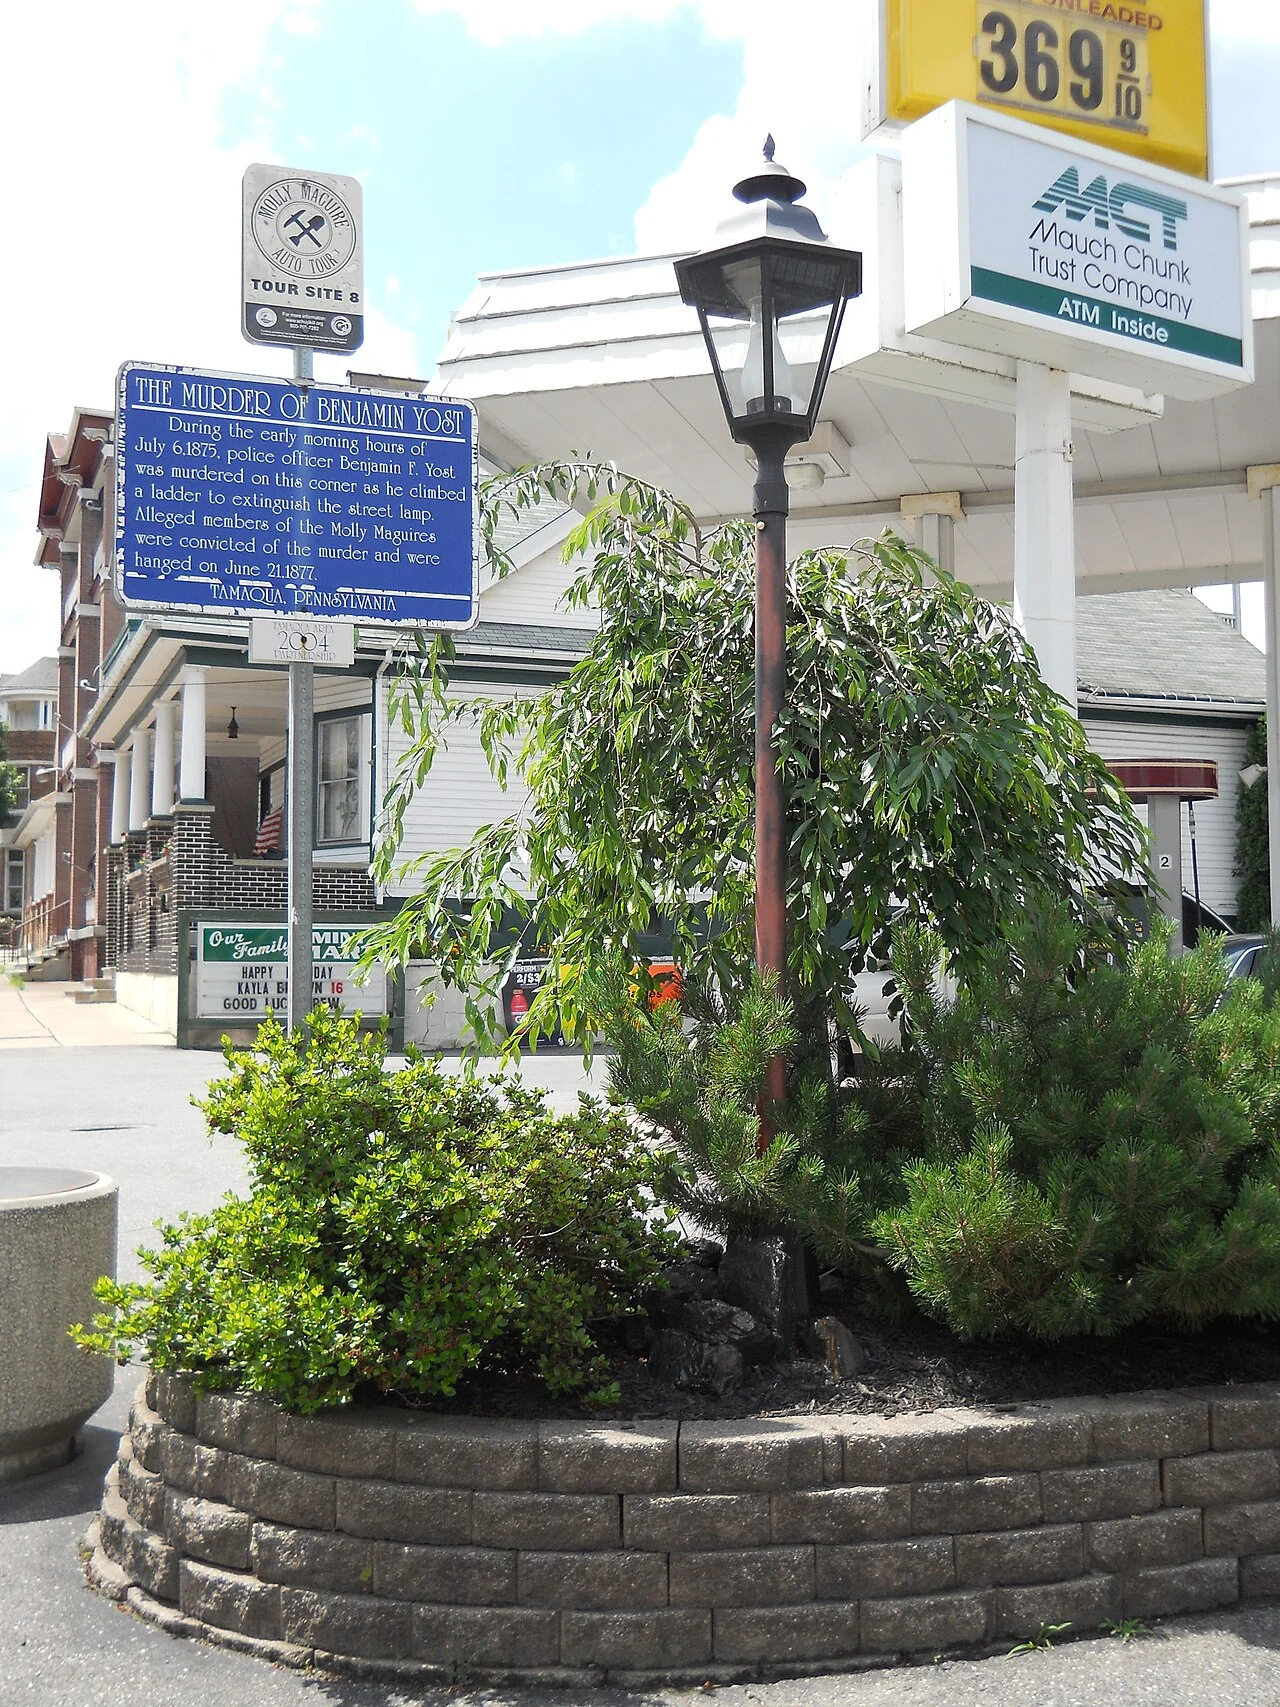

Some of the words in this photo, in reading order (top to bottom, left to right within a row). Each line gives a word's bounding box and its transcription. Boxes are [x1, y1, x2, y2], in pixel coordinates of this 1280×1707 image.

[980, 11, 1103, 111] 369
[258, 185, 292, 220] MOLLY
[301, 184, 350, 229] MAGUIRE
[1032, 165, 1188, 251] MCT
[272, 248, 302, 272] AUTO
[309, 253, 339, 274] TOUR
[1029, 219, 1116, 263] Mauch
[1124, 245, 1191, 285] Chunk
[251, 278, 299, 295] TOUR
[305, 286, 343, 301] SITE
[349, 292, 360, 303] 8
[1028, 247, 1076, 283] Trust
[1084, 263, 1193, 319] Company
[1058, 297, 1100, 325] ATM
[1111, 311, 1168, 342] Inside
[136, 377, 172, 406] THE
[182, 383, 271, 416] MURDER
[280, 393, 308, 420] OF
[317, 397, 404, 430] BENJAMIN
[413, 407, 464, 435] YOST
[169, 416, 221, 441] During
[229, 423, 254, 438] the
[261, 428, 296, 448] early
[304, 434, 358, 454] morning
[366, 435, 405, 453] hours
[411, 441, 427, 456] of
[135, 437, 165, 458] July
[227, 446, 275, 464] police
[282, 450, 334, 468] officer
[341, 455, 401, 477] Benjamin
[408, 461, 419, 476] F.
[425, 462, 456, 479] Yost
[135, 464, 164, 476] was
[171, 465, 244, 483] murdered
[251, 474, 269, 485] on
[275, 472, 303, 488] this
[309, 478, 357, 493] corner
[363, 483, 380, 496] as
[386, 481, 404, 497] he
[409, 484, 466, 502] climbed
[134, 487, 143, 498] a
[151, 484, 201, 503] ladder
[209, 489, 226, 504] to
[232, 493, 310, 514] extinguish
[317, 498, 342, 514] the
[348, 502, 393, 518] street
[400, 504, 434, 522] lamp.
[135, 507, 195, 528] Alleged
[203, 511, 269, 530] members
[276, 517, 294, 532] of
[300, 519, 324, 535] the
[331, 522, 366, 542] Molly
[374, 525, 437, 545] Maguires
[134, 552, 192, 575] hanged
[199, 560, 218, 573] on
[225, 560, 260, 576] June
[135, 534, 173, 547] were
[180, 536, 255, 553] convicted
[262, 539, 281, 555] of
[287, 540, 311, 556] the
[318, 546, 368, 560] murder
[374, 549, 400, 562] and
[407, 552, 441, 565] were
[294, 590, 397, 612] PENNSYLVANIA
[278, 630, 329, 652] 2004
[1161, 857, 1169, 867] 2
[209, 931, 244, 947] Our
[312, 931, 363, 944] MIN
[238, 982, 269, 994] KAYLA
[331, 982, 343, 993] 16
[242, 966, 273, 979] HAPPY
[223, 998, 257, 1010] GOOD
